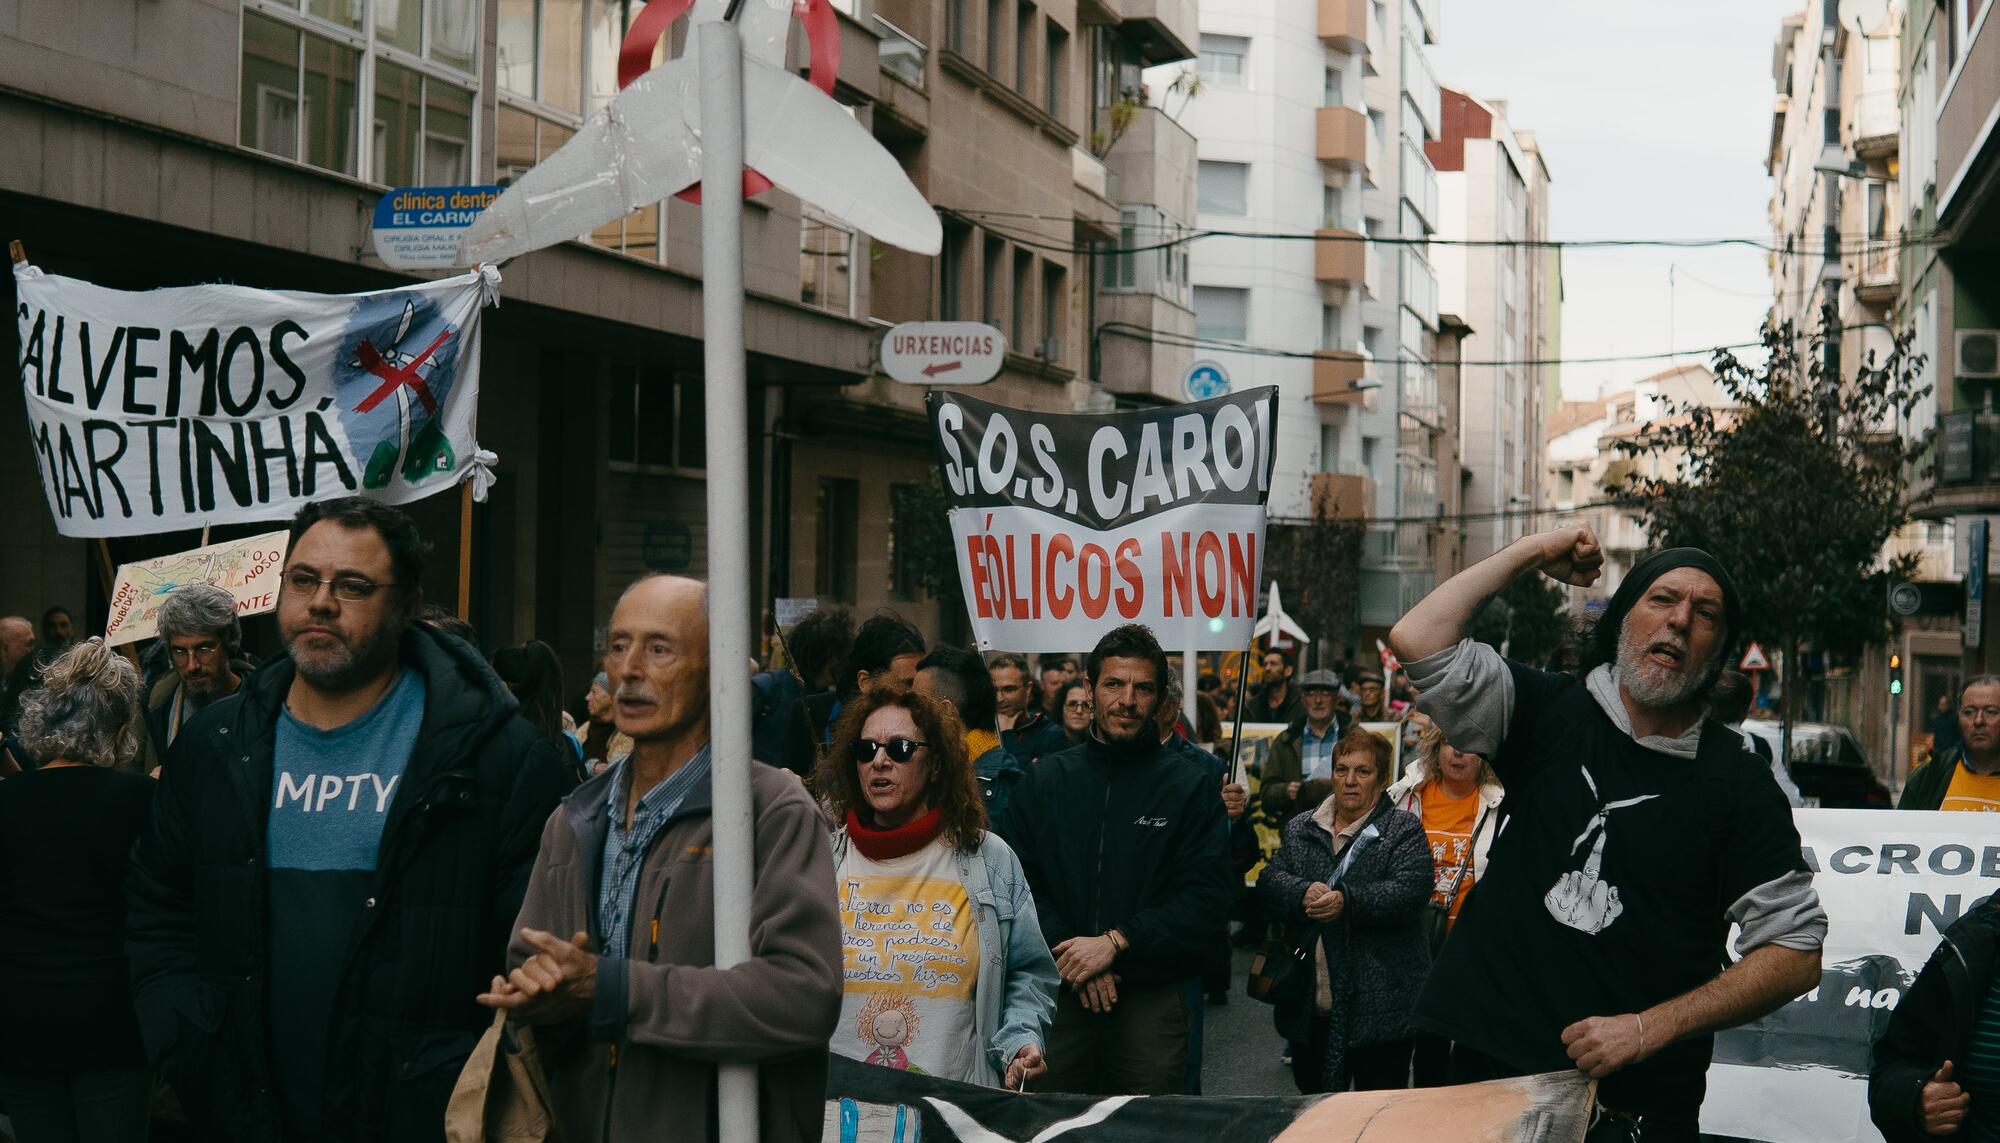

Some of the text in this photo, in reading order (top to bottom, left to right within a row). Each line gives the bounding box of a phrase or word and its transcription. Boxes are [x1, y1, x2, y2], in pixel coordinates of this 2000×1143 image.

[393, 212, 415, 225] EL
[893, 335, 992, 355] URXENCIAS
[17, 302, 309, 417] ALVEMOS
[244, 550, 281, 584] NOSO
[252, 550, 262, 561] O
[967, 513, 1255, 620] EÓLICOS NON
[112, 582, 131, 608] NON
[235, 592, 273, 612] NTE
[847, 881, 893, 915] Tierra
[907, 902, 923, 914] no
[932, 902, 953, 914] es
[855, 913, 953, 931] herencia de
[1904, 892, 1990, 935] N
[859, 954, 879, 965] un
[913, 965, 961, 988] hijos
